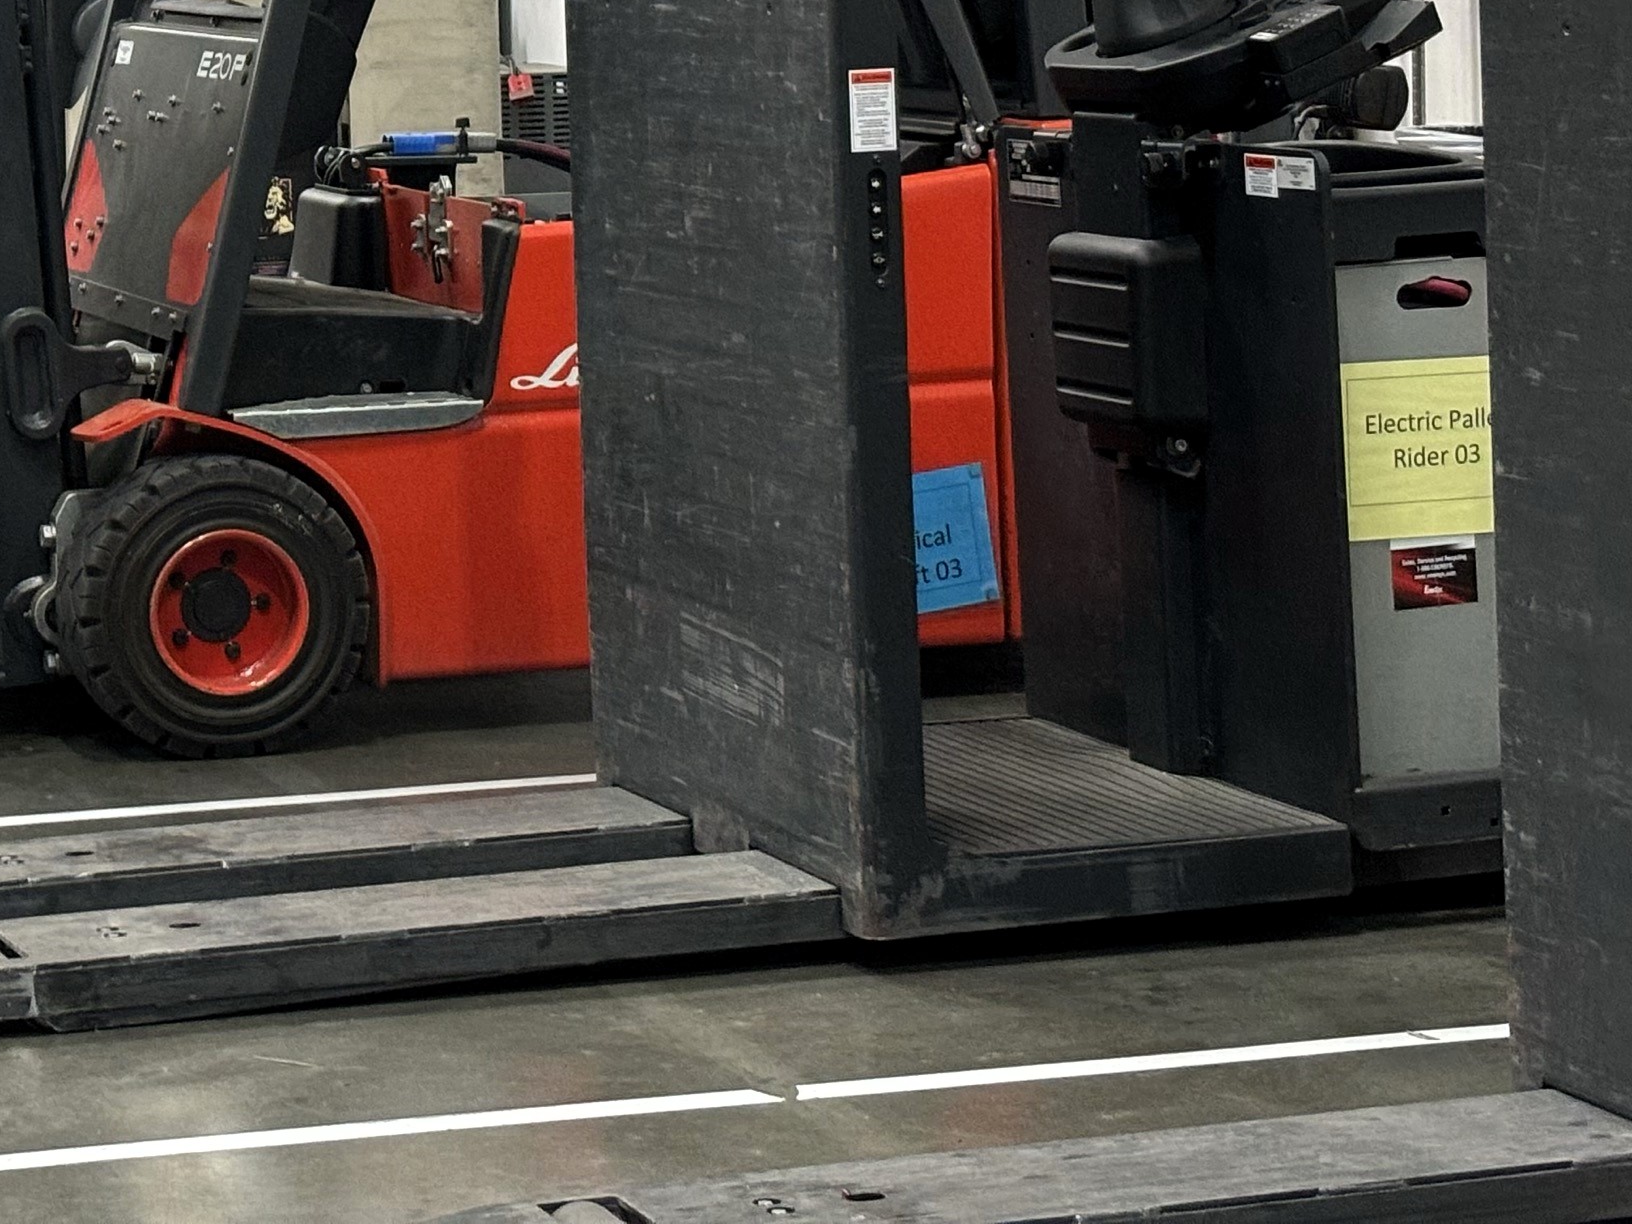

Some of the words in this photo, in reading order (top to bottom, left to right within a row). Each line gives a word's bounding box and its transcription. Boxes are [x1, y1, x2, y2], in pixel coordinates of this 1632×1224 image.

[510, 342, 580, 390] Li
[1365, 410, 1443, 435] Electric
[1394, 445, 1449, 468] Rider
[1455, 443, 1481, 465] 03
[916, 523, 952, 549] ical
[935, 558, 962, 581] 03
